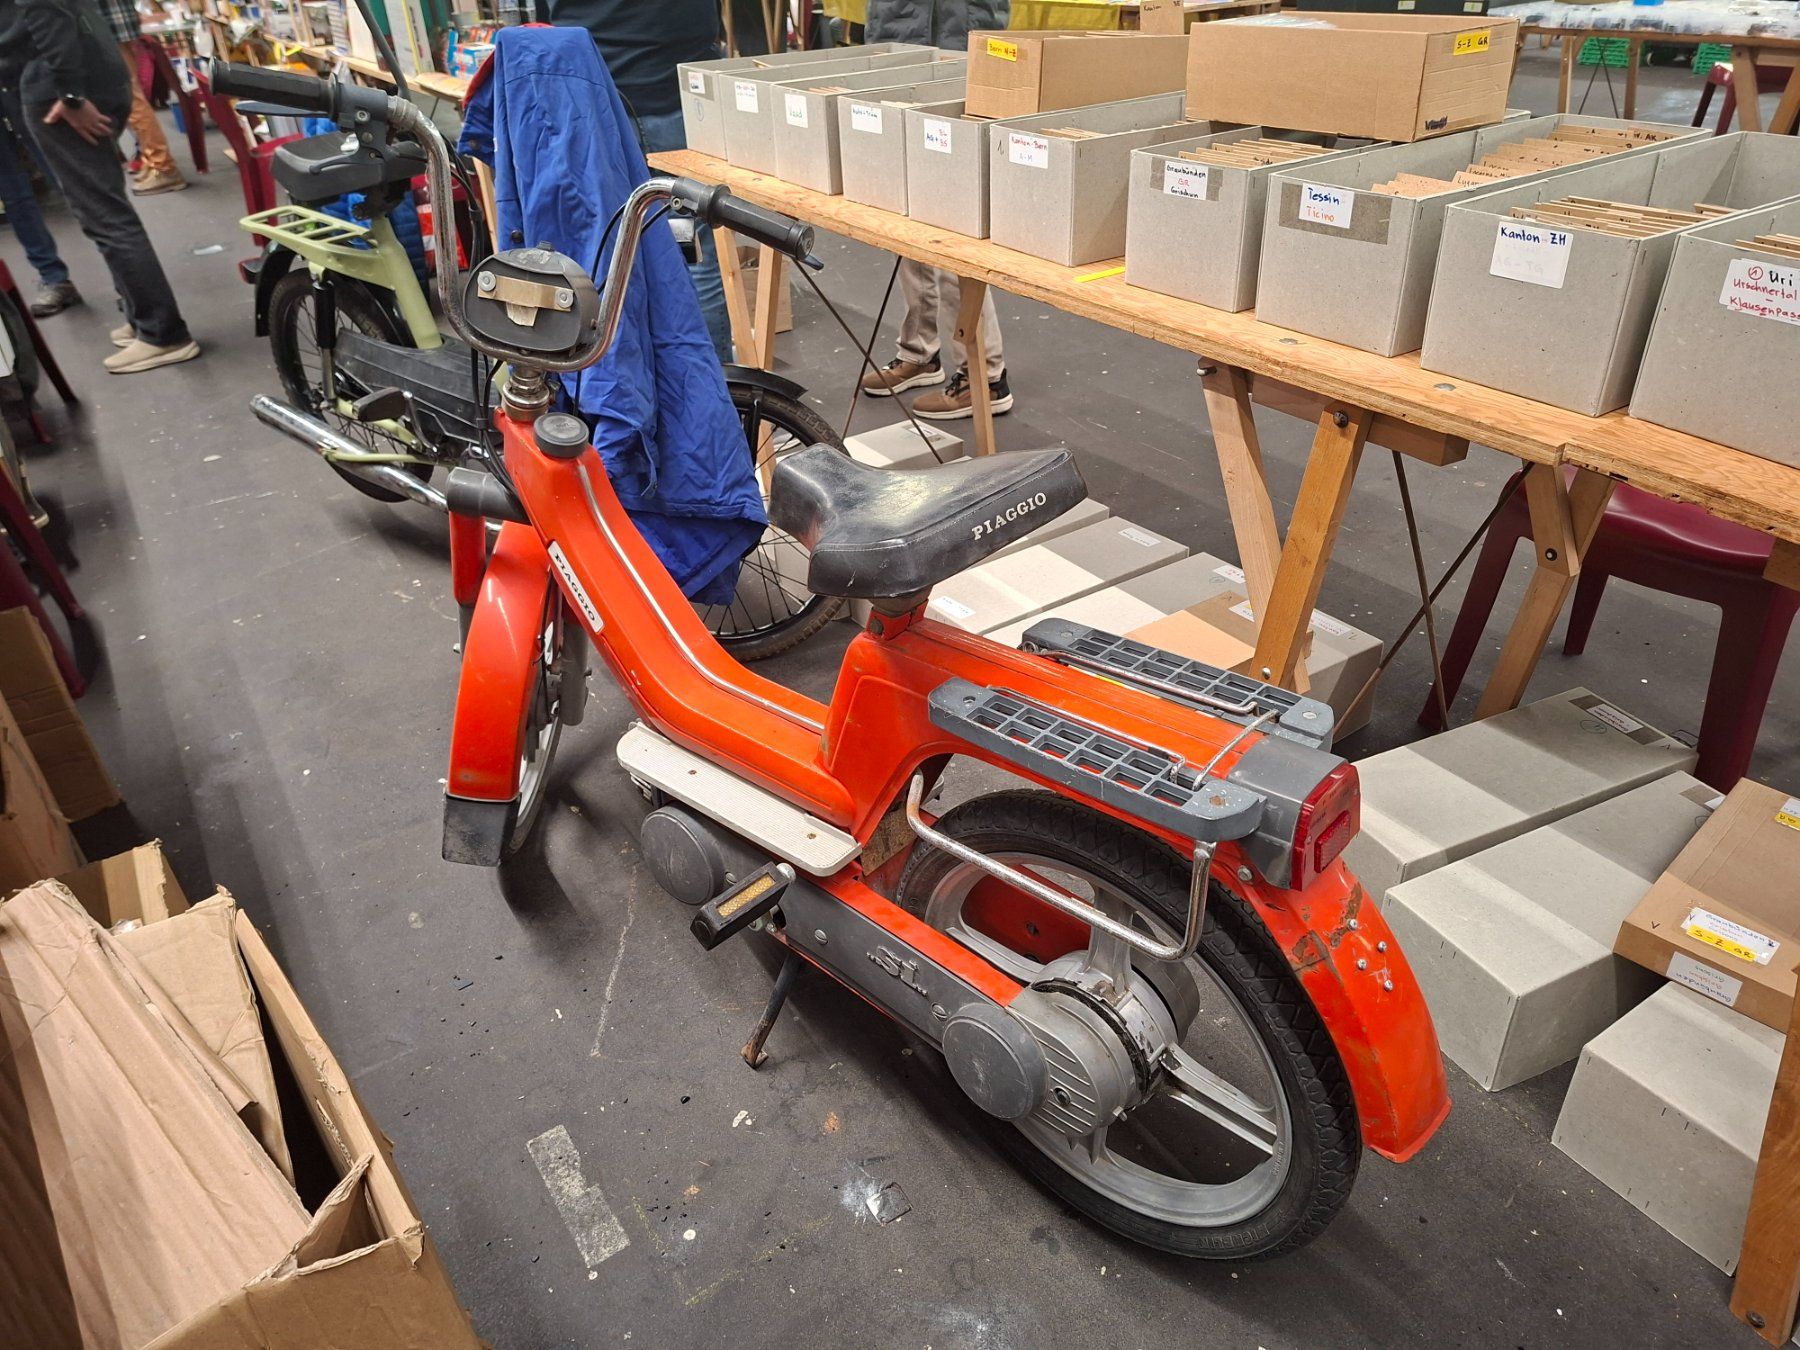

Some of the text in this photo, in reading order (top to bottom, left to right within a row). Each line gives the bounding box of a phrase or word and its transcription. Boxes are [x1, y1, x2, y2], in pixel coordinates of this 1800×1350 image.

[1477, 36, 1488, 46] GR
[1307, 187, 1340, 205] Tessin
[1306, 205, 1335, 222] Ticino
[1500, 226, 1567, 246] Kanton ZH
[1769, 270, 1793, 287] Uri
[1733, 278, 1797, 301] Urschnertal
[971, 491, 1047, 541] PIAGGIO
[555, 553, 596, 621] PIAGGIO
